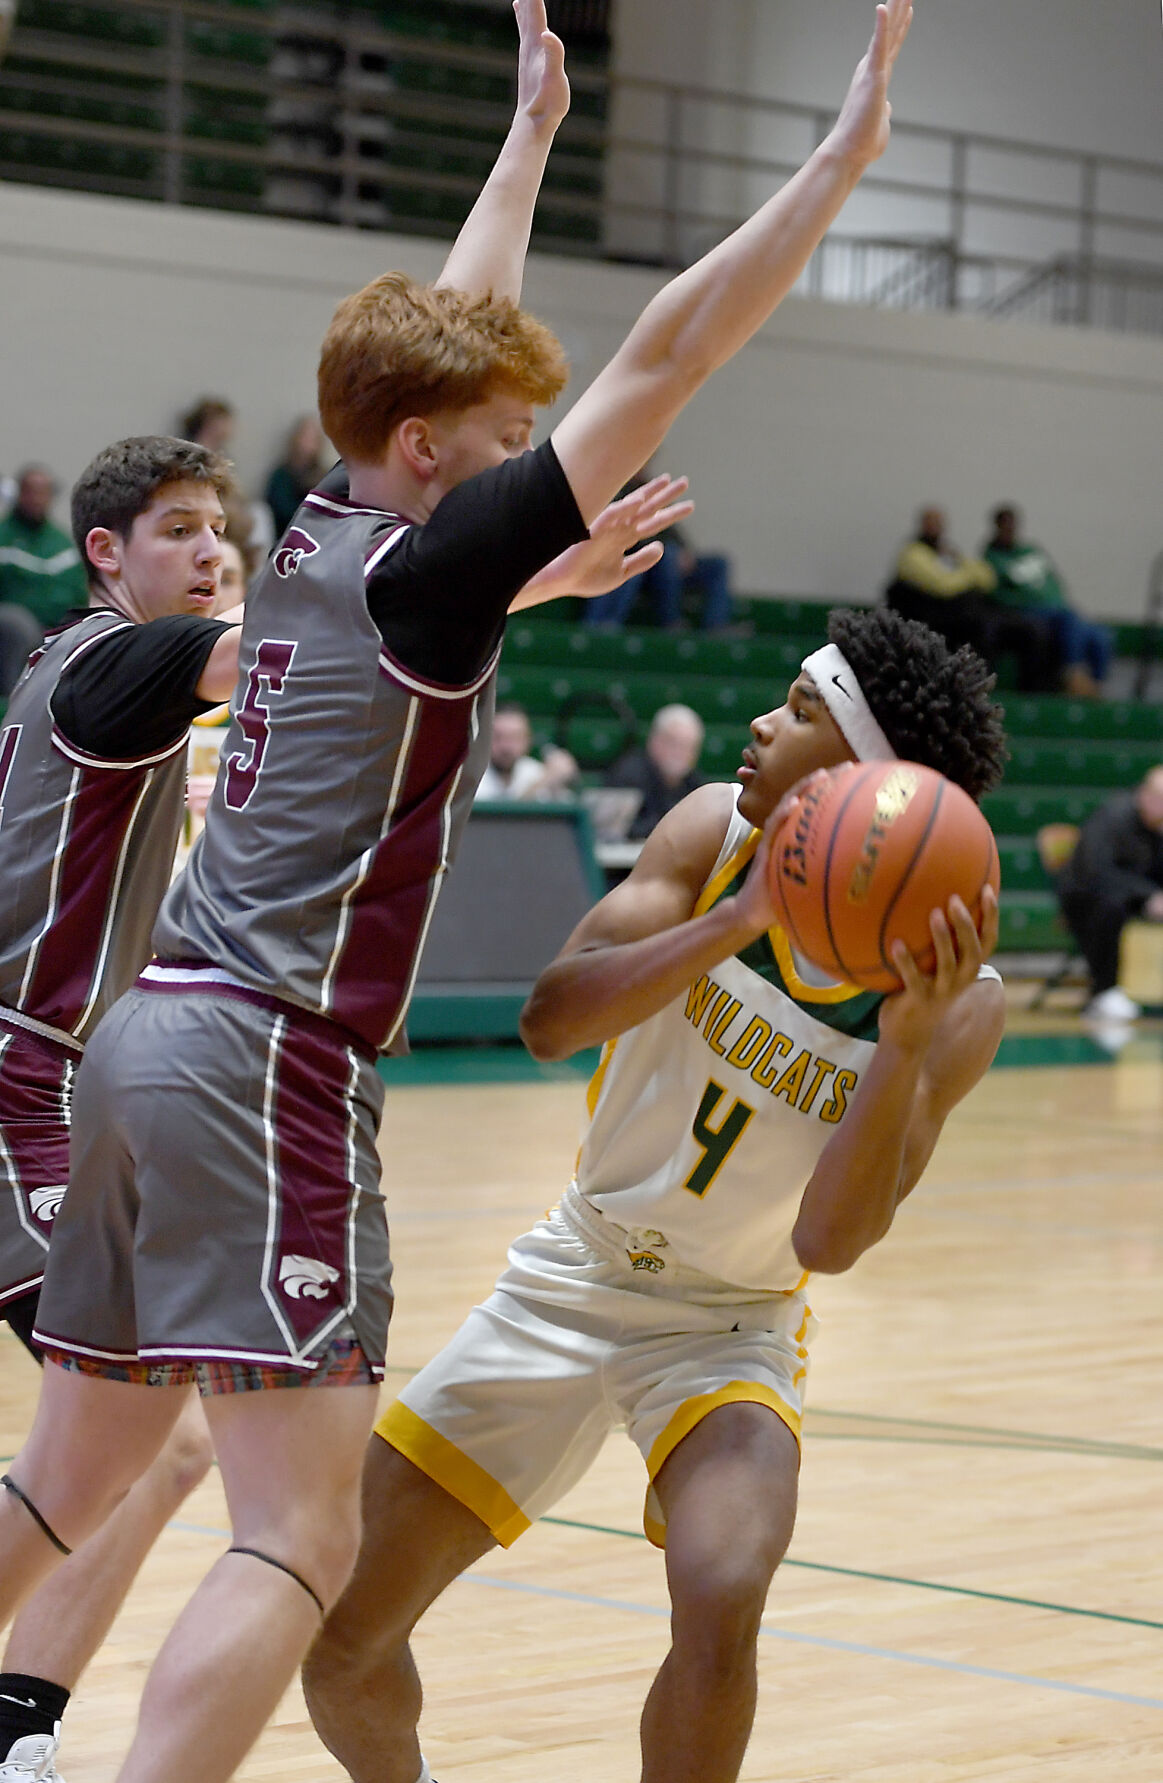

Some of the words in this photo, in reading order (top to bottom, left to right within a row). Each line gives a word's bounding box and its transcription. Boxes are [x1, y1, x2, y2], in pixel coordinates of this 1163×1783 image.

[224, 638, 298, 812] 5
[684, 974, 858, 1124] WILDCATS
[682, 1076, 757, 1198] 4
